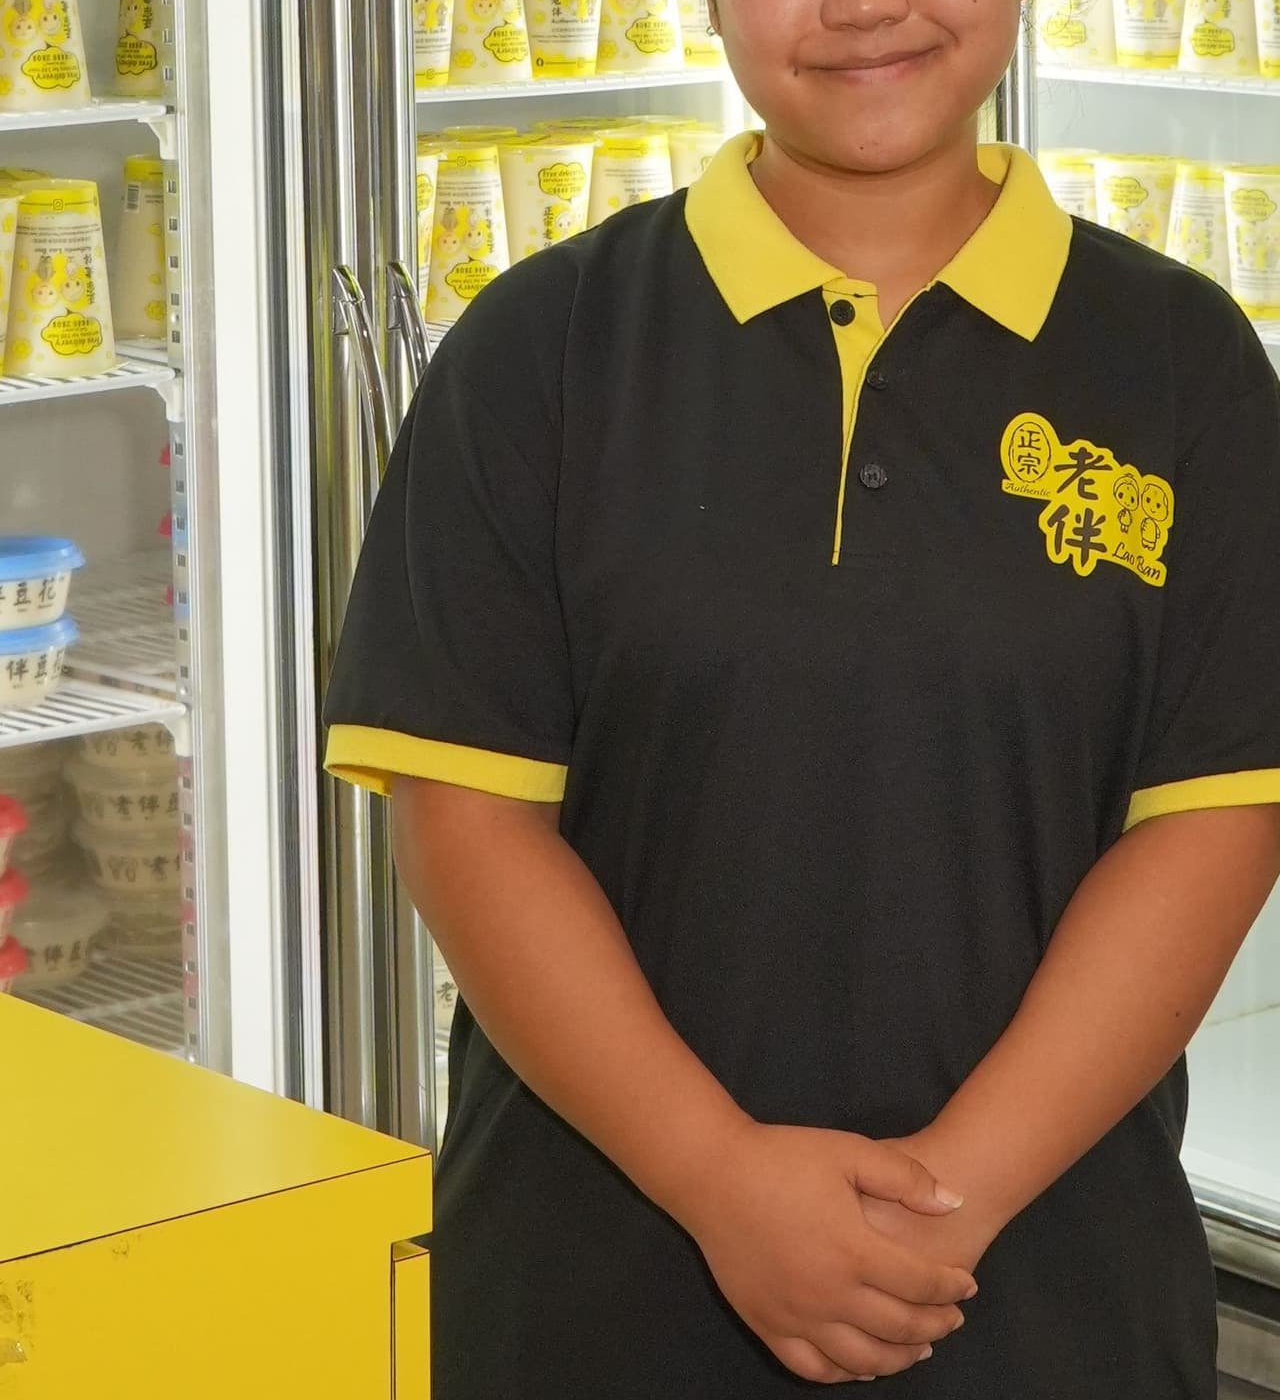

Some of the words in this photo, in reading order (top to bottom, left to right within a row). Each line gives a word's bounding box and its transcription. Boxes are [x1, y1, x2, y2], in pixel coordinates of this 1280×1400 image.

[1017, 429, 1042, 475] 正宗
[1004, 482, 1052, 497] Authentic
[1047, 447, 1113, 566] 老伴
